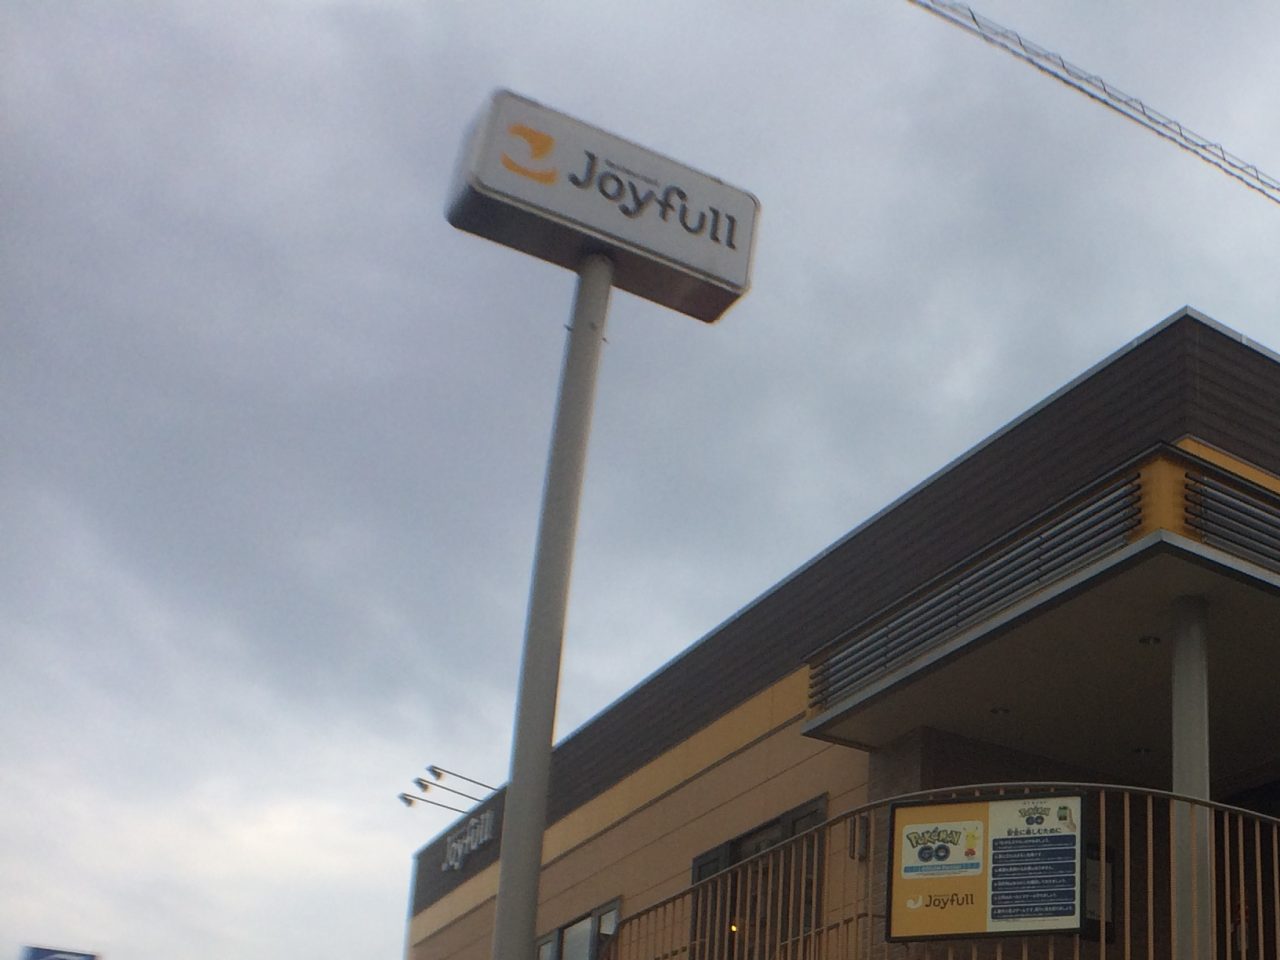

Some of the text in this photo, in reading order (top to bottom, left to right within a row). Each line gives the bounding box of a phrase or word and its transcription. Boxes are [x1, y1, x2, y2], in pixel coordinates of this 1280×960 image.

[568, 150, 737, 250] Joyfull
[917, 844, 951, 862] GO
[925, 893, 974, 910] Joyfull
